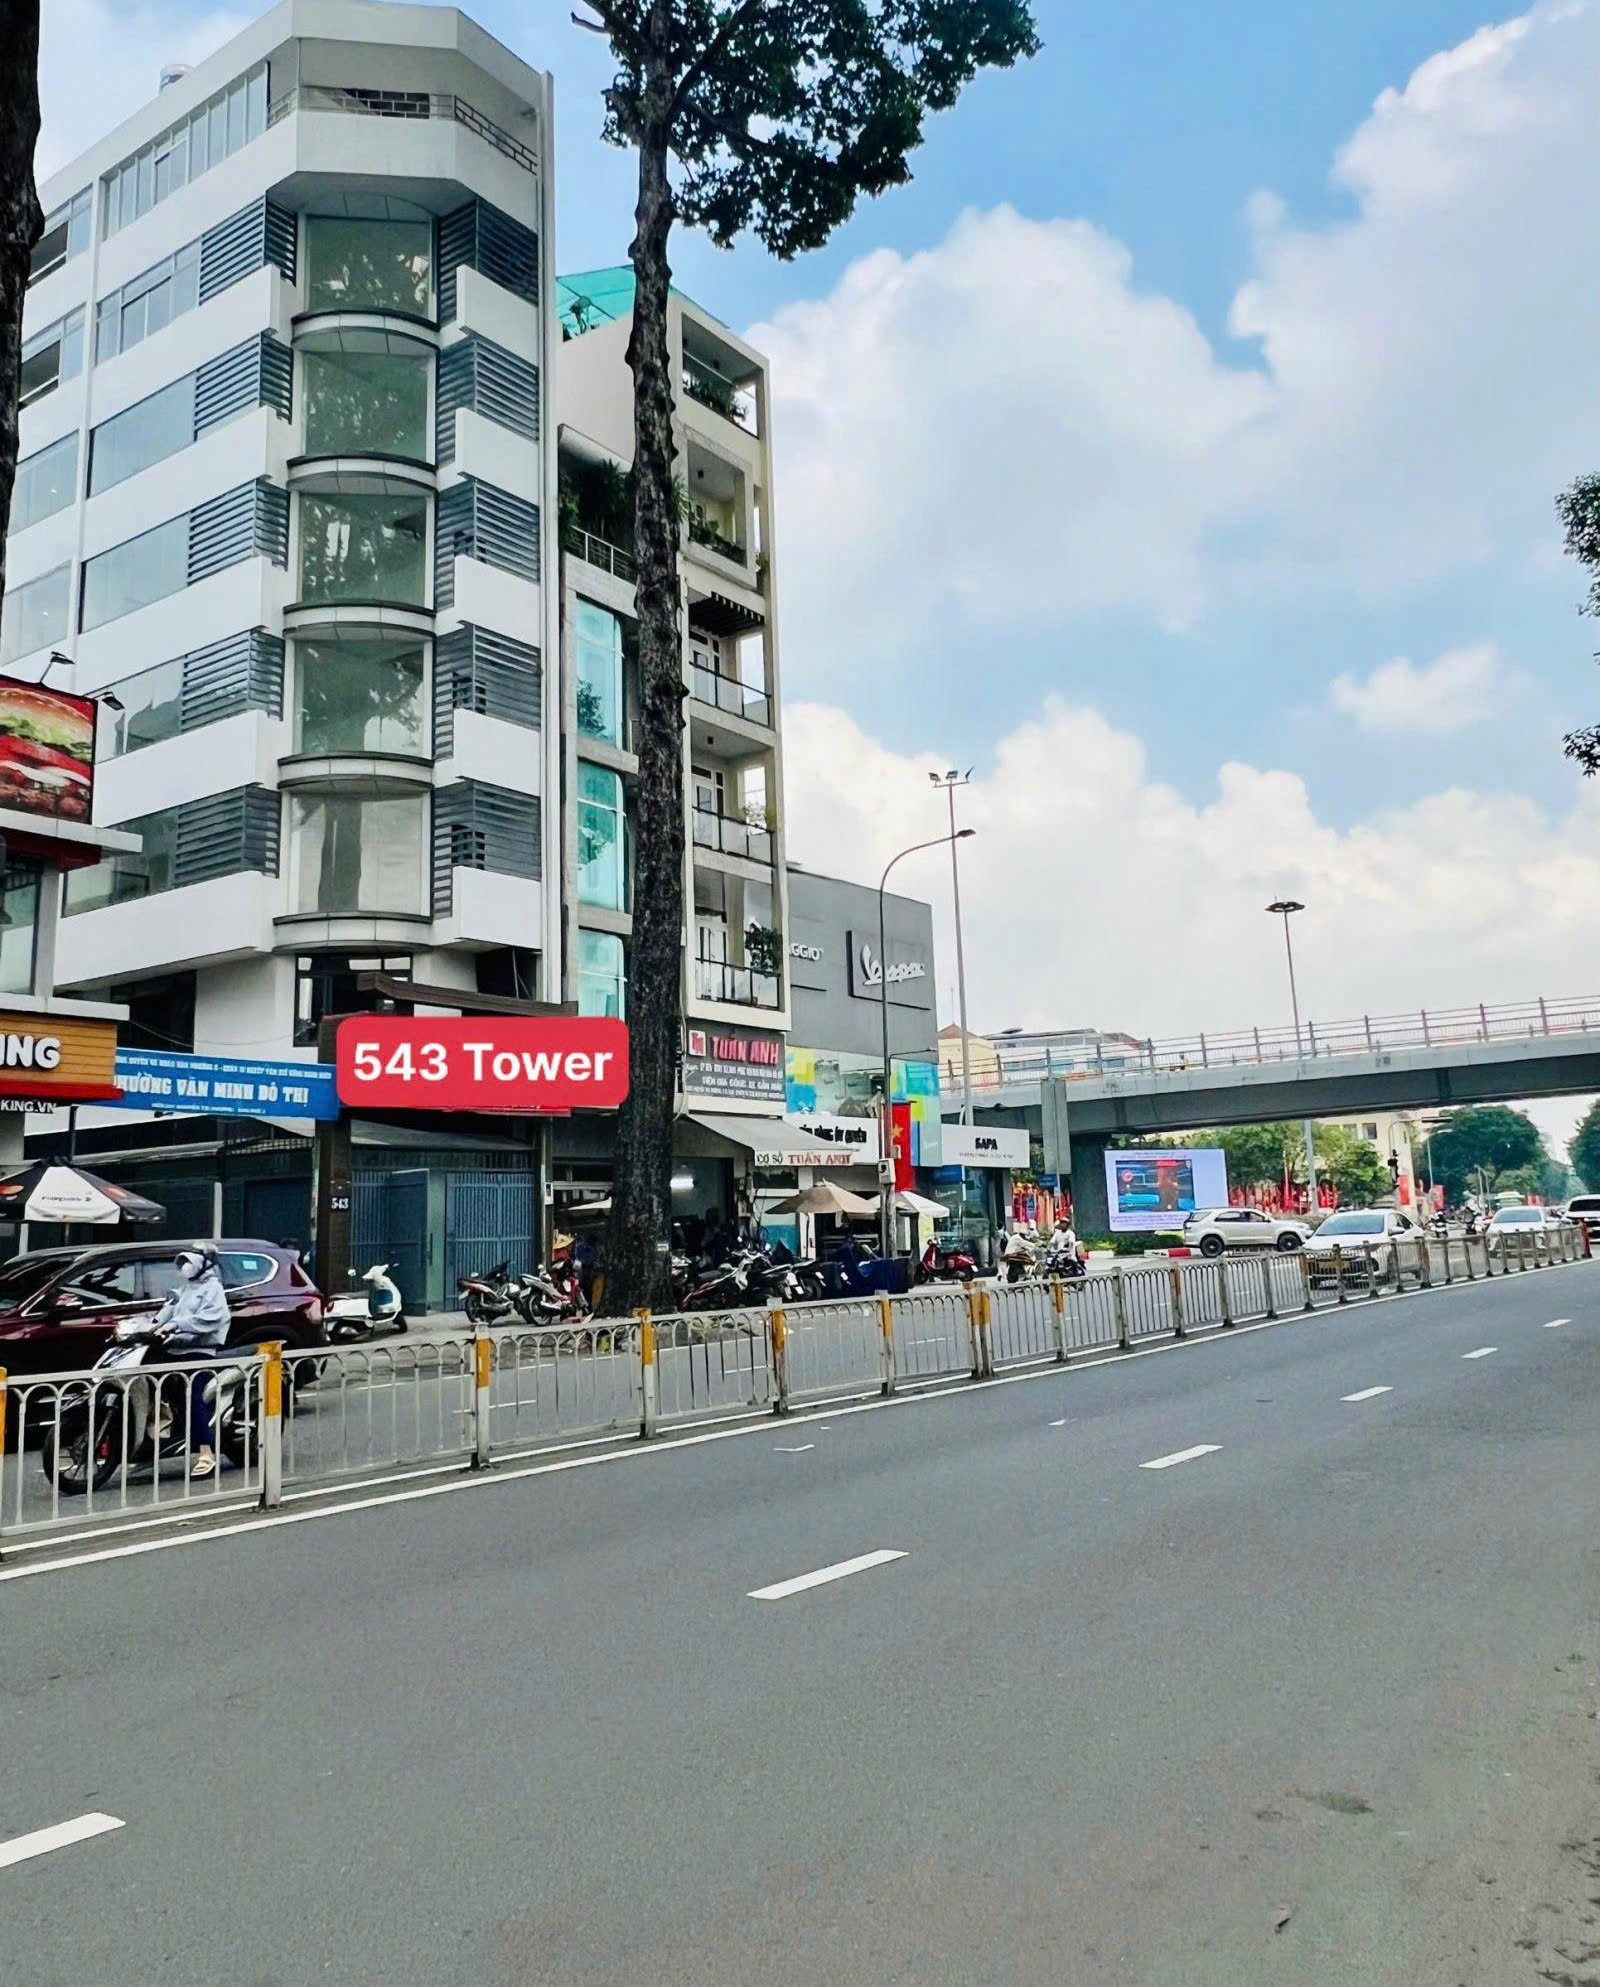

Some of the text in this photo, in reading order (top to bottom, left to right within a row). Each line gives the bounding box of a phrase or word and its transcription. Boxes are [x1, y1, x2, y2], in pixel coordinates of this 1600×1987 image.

[789, 943, 820, 960] GGIO
[0, 1033, 61, 1068] ING
[750, 1040, 779, 1064] ANH
[213, 1081, 254, 1100] MINH
